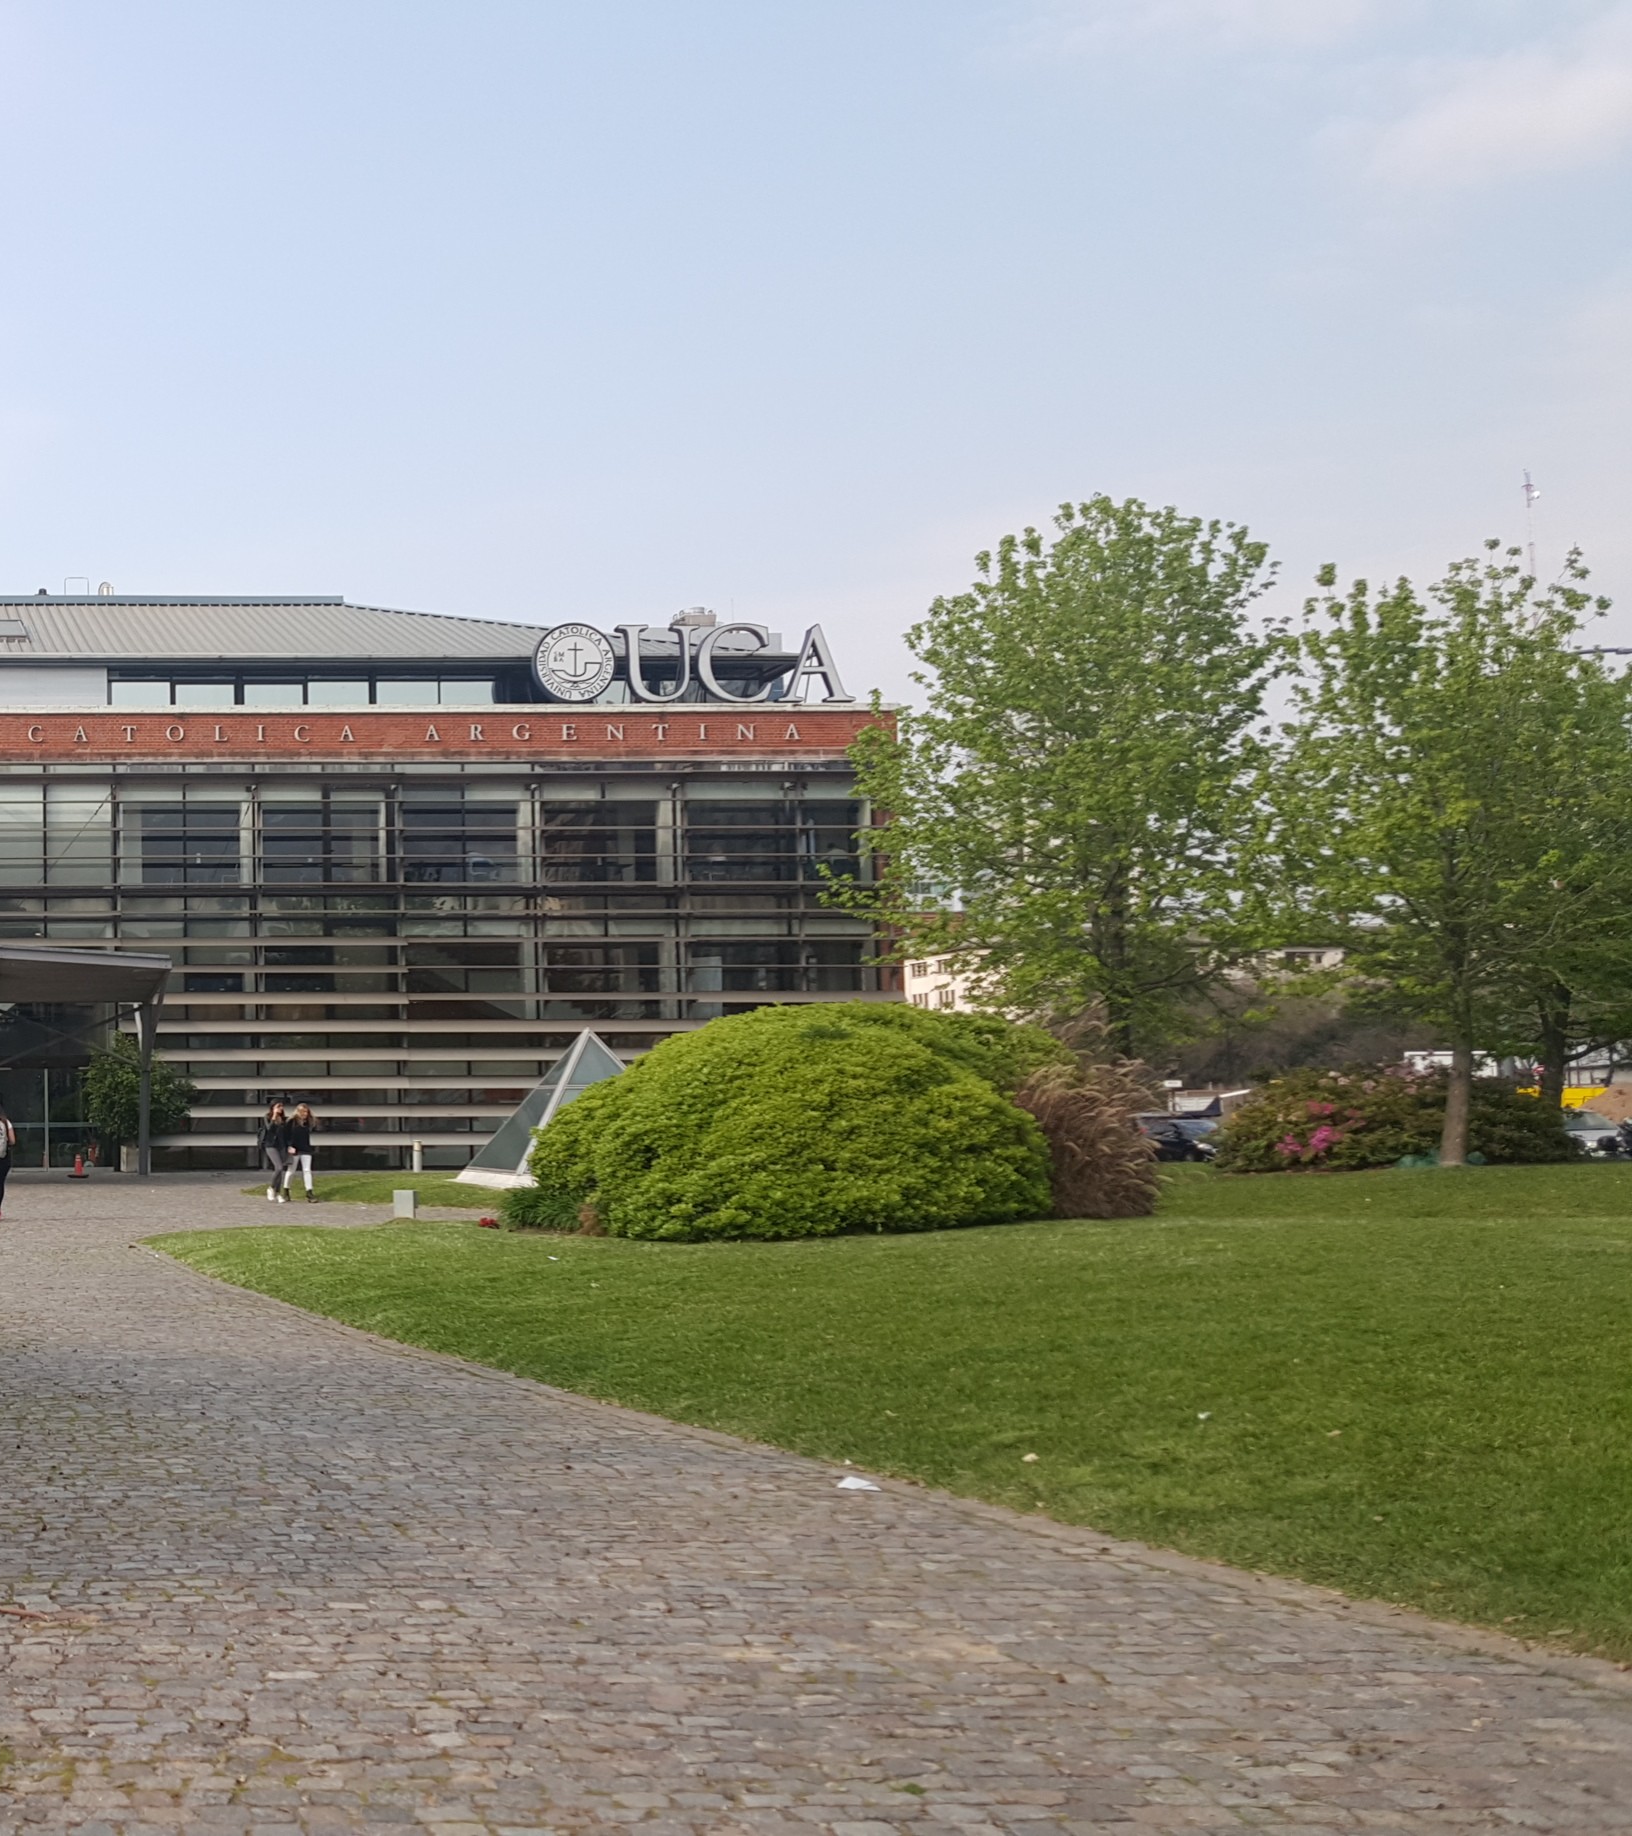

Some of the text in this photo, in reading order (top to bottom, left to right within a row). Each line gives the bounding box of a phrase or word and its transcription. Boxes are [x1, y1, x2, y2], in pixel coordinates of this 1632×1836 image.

[538, 626, 613, 699] UNIVERSIDAD CATOLICA ARGENTINA
[614, 623, 857, 702] UCA
[28, 724, 356, 743] CATOLICA
[423, 723, 802, 742] ARGENTINA
